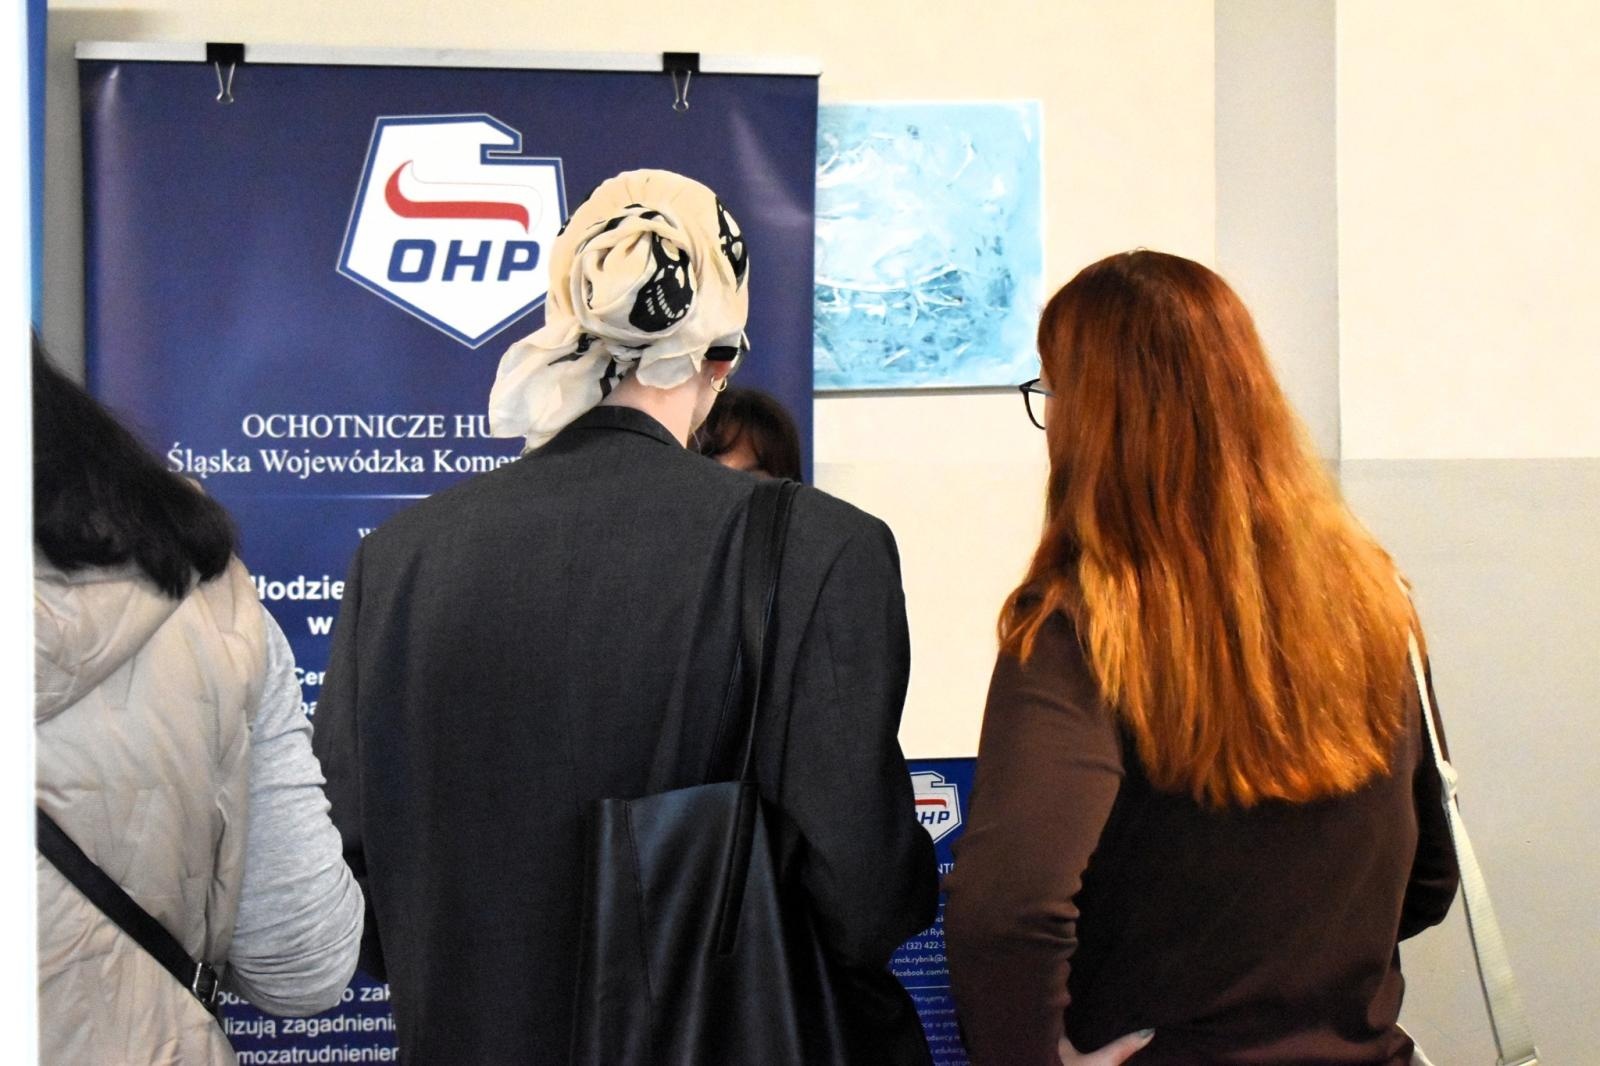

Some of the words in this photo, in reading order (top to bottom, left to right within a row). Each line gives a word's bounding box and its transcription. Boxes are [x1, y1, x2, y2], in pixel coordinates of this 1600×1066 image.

[387, 238, 541, 283] OHP
[241, 414, 446, 438] OCHOTNICZE
[167, 443, 252, 479] Śląska
[260, 448, 425, 479] Wojewódzka
[250, 575, 345, 600] łodzie
[307, 616, 333, 635] w
[915, 811, 950, 825] HP
[224, 1016, 276, 1039] lizują
